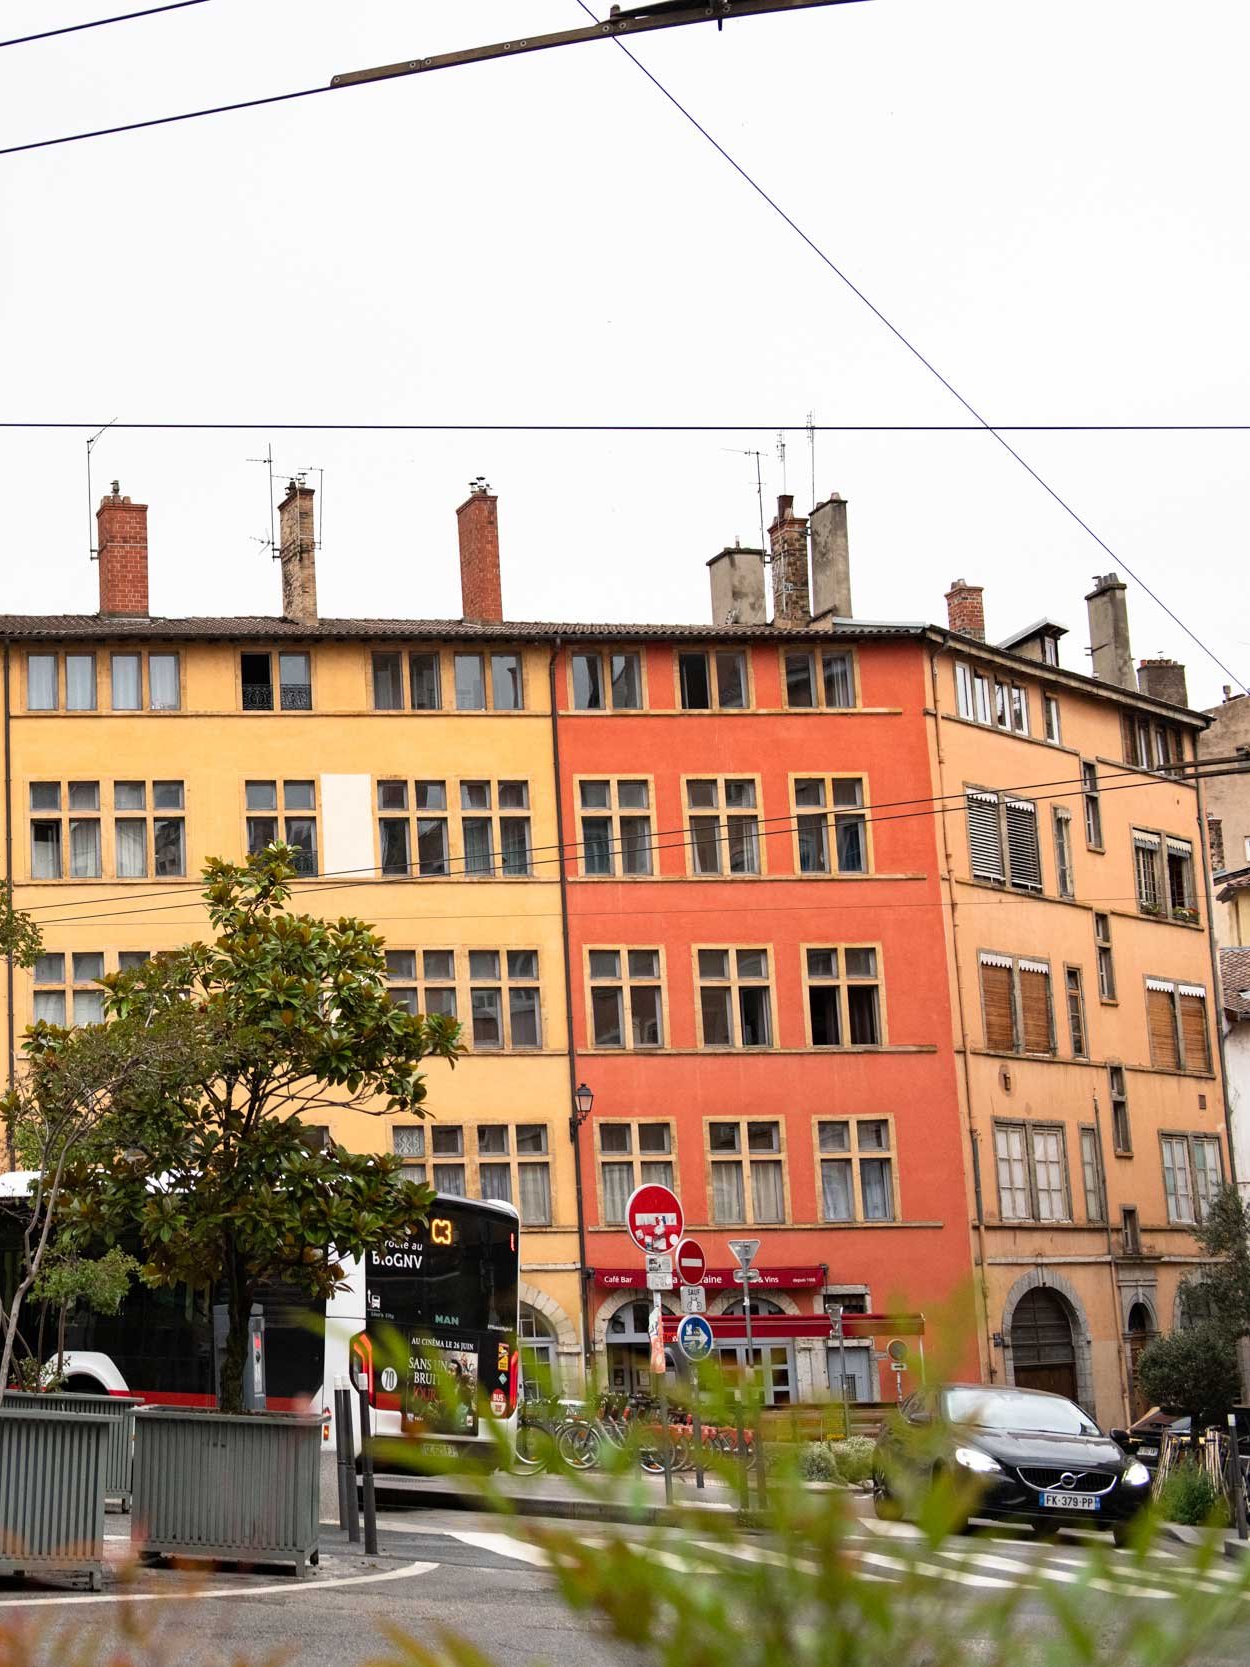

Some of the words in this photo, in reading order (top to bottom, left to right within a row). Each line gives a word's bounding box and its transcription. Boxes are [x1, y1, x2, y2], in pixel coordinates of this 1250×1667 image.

[431, 1219, 452, 1245] C3
[411, 1242, 423, 1251] au
[604, 1275, 620, 1283] Café
[435, 1314, 459, 1326] MAN
[411, 1337, 421, 1345] AU
[421, 1338, 445, 1348] CINÉMA
[445, 1340, 453, 1349] LE
[453, 1341, 460, 1349] 26
[460, 1342, 474, 1351] JUIN
[408, 1356, 432, 1371] SANS
[385, 1370, 395, 1389] 70
[493, 1393, 504, 1402] BUS
